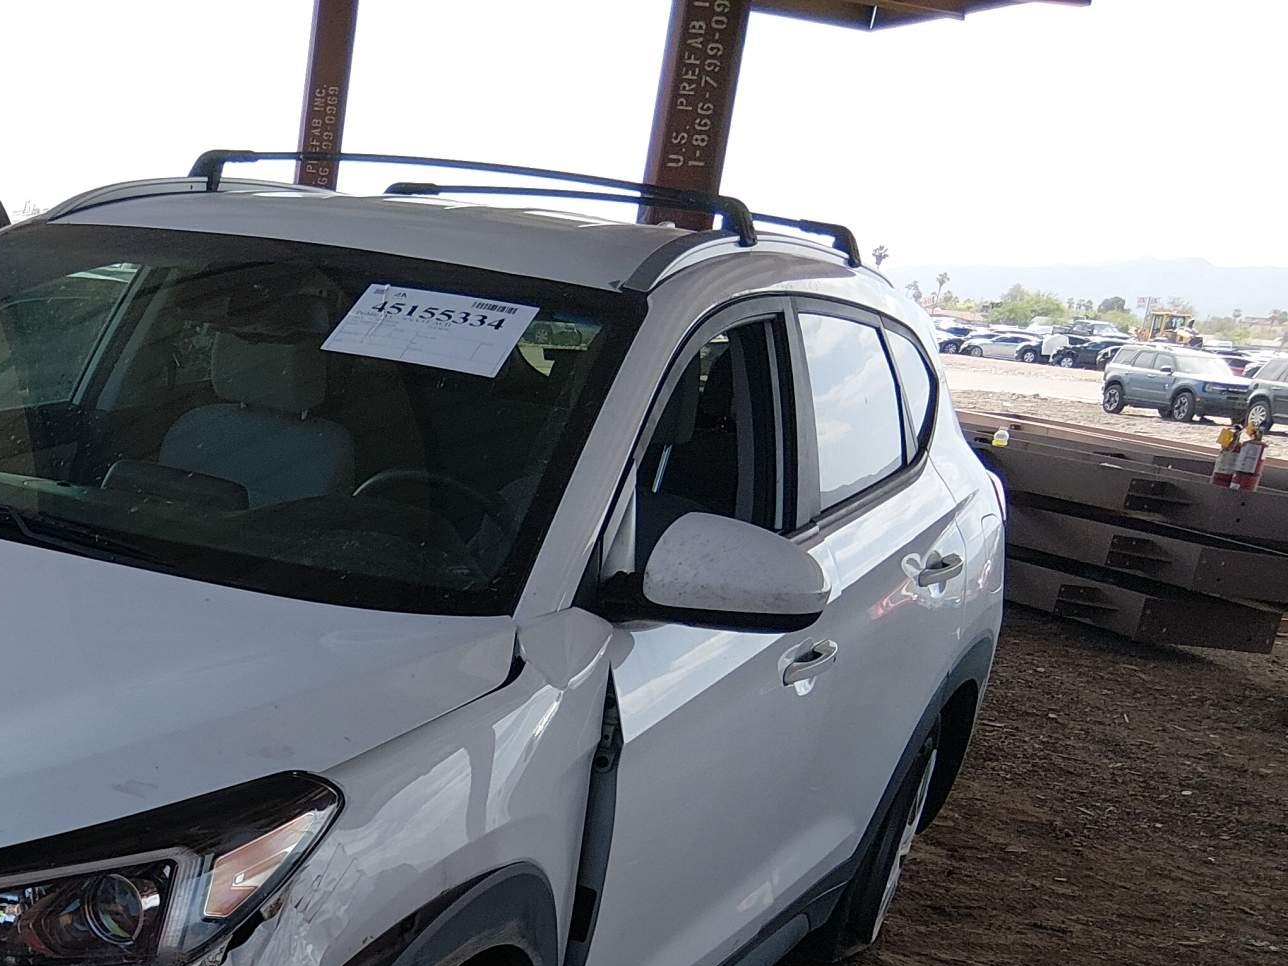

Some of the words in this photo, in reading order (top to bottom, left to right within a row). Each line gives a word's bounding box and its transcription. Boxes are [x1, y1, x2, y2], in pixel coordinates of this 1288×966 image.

[676, 20, 706, 110] PREFAB
[305, 119, 323, 174] PEFAB
[666, 124, 690, 168] U.S.
[371, 300, 506, 330] 45155334
